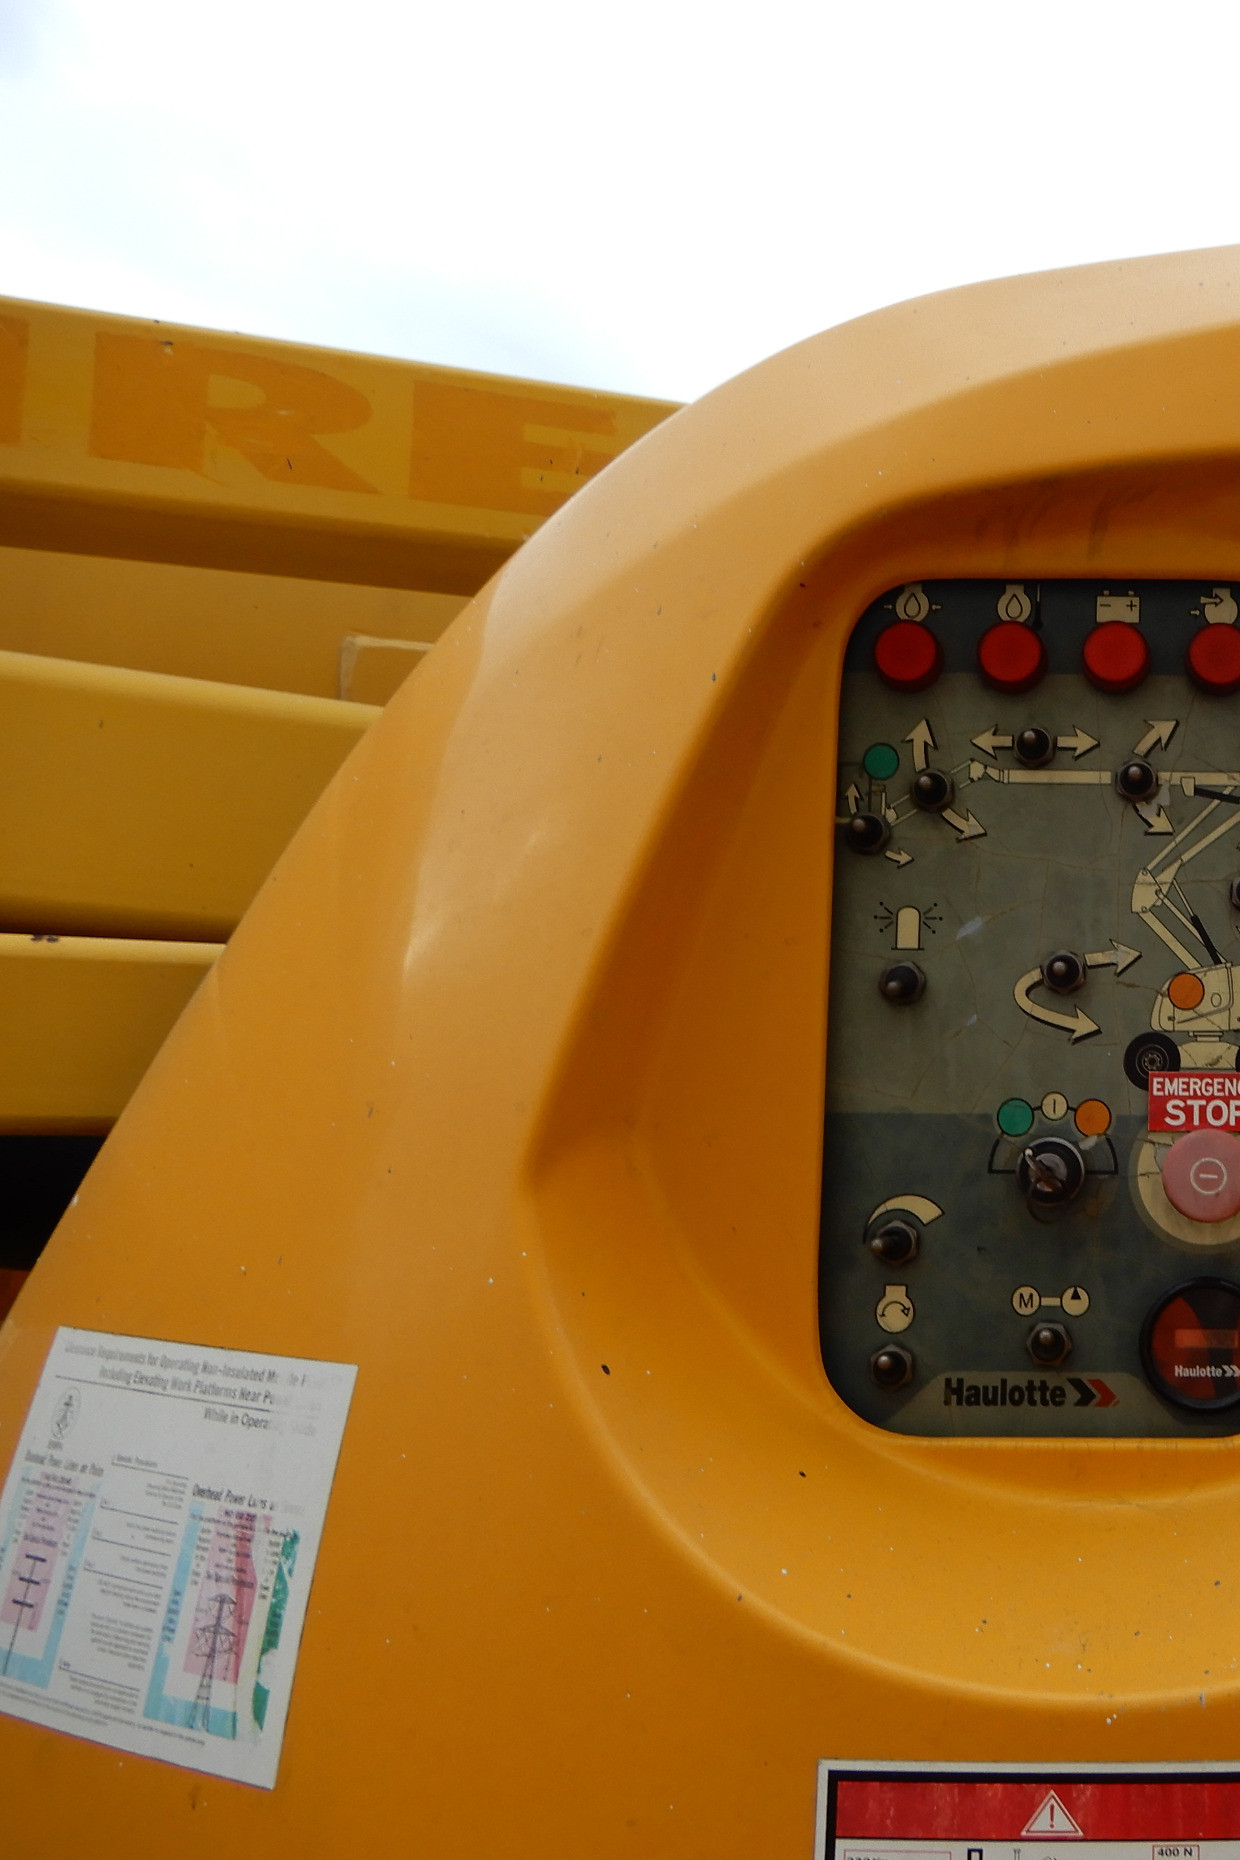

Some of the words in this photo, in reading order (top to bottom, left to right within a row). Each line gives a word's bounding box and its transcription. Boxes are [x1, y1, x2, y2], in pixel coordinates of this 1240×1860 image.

[0, 315, 618, 518] RE
[1019, 1292, 1034, 1308] M
[1174, 1365, 1223, 1377] Haulotte
[943, 1377, 1066, 1407] Haulotte
